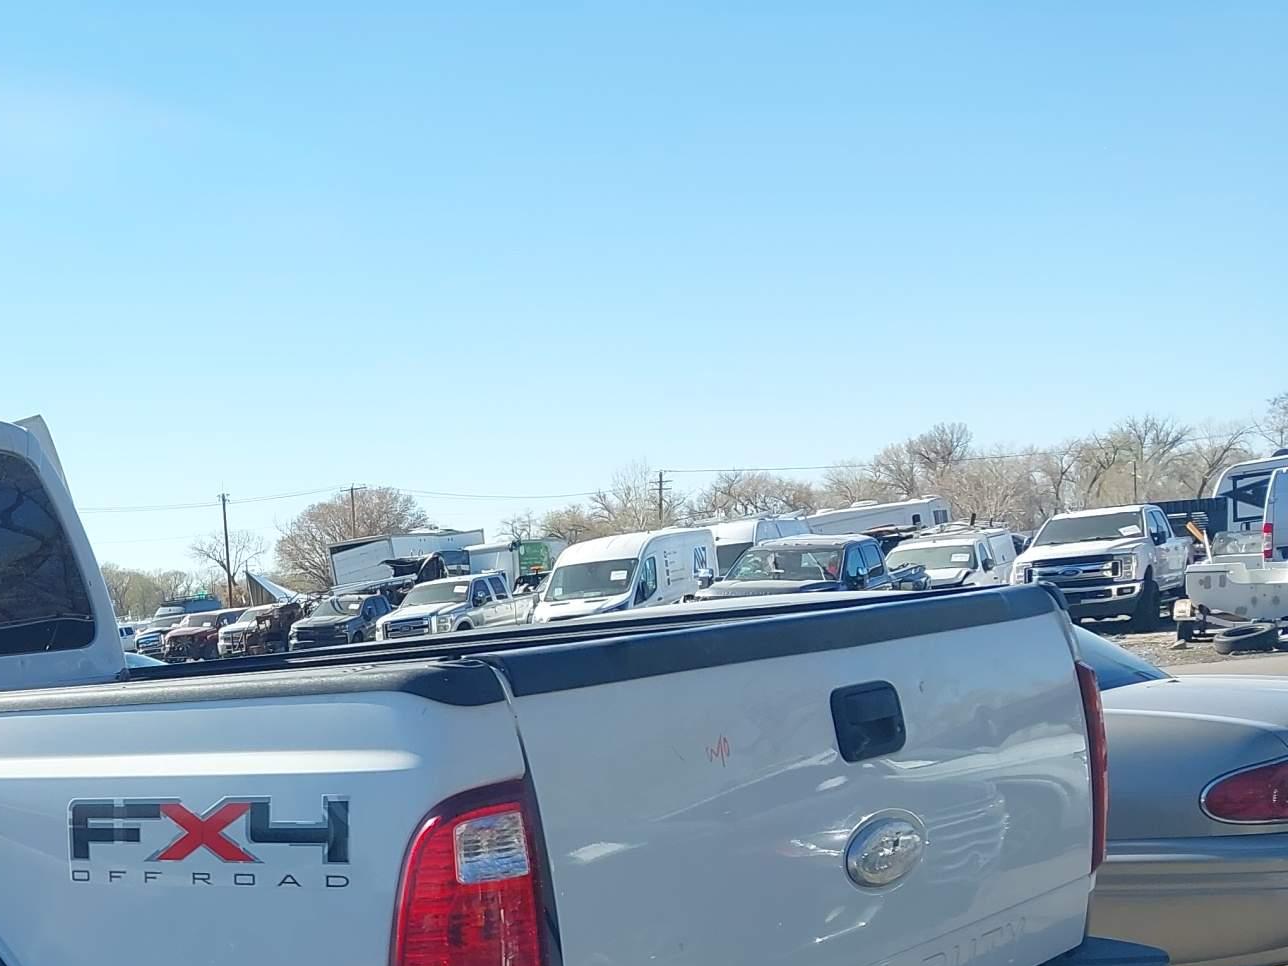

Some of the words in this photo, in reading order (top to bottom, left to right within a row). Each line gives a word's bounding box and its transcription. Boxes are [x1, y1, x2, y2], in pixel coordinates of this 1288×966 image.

[68, 794, 350, 865] FX4
[71, 870, 162, 884] OFF
[192, 872, 349, 888] ROAD
